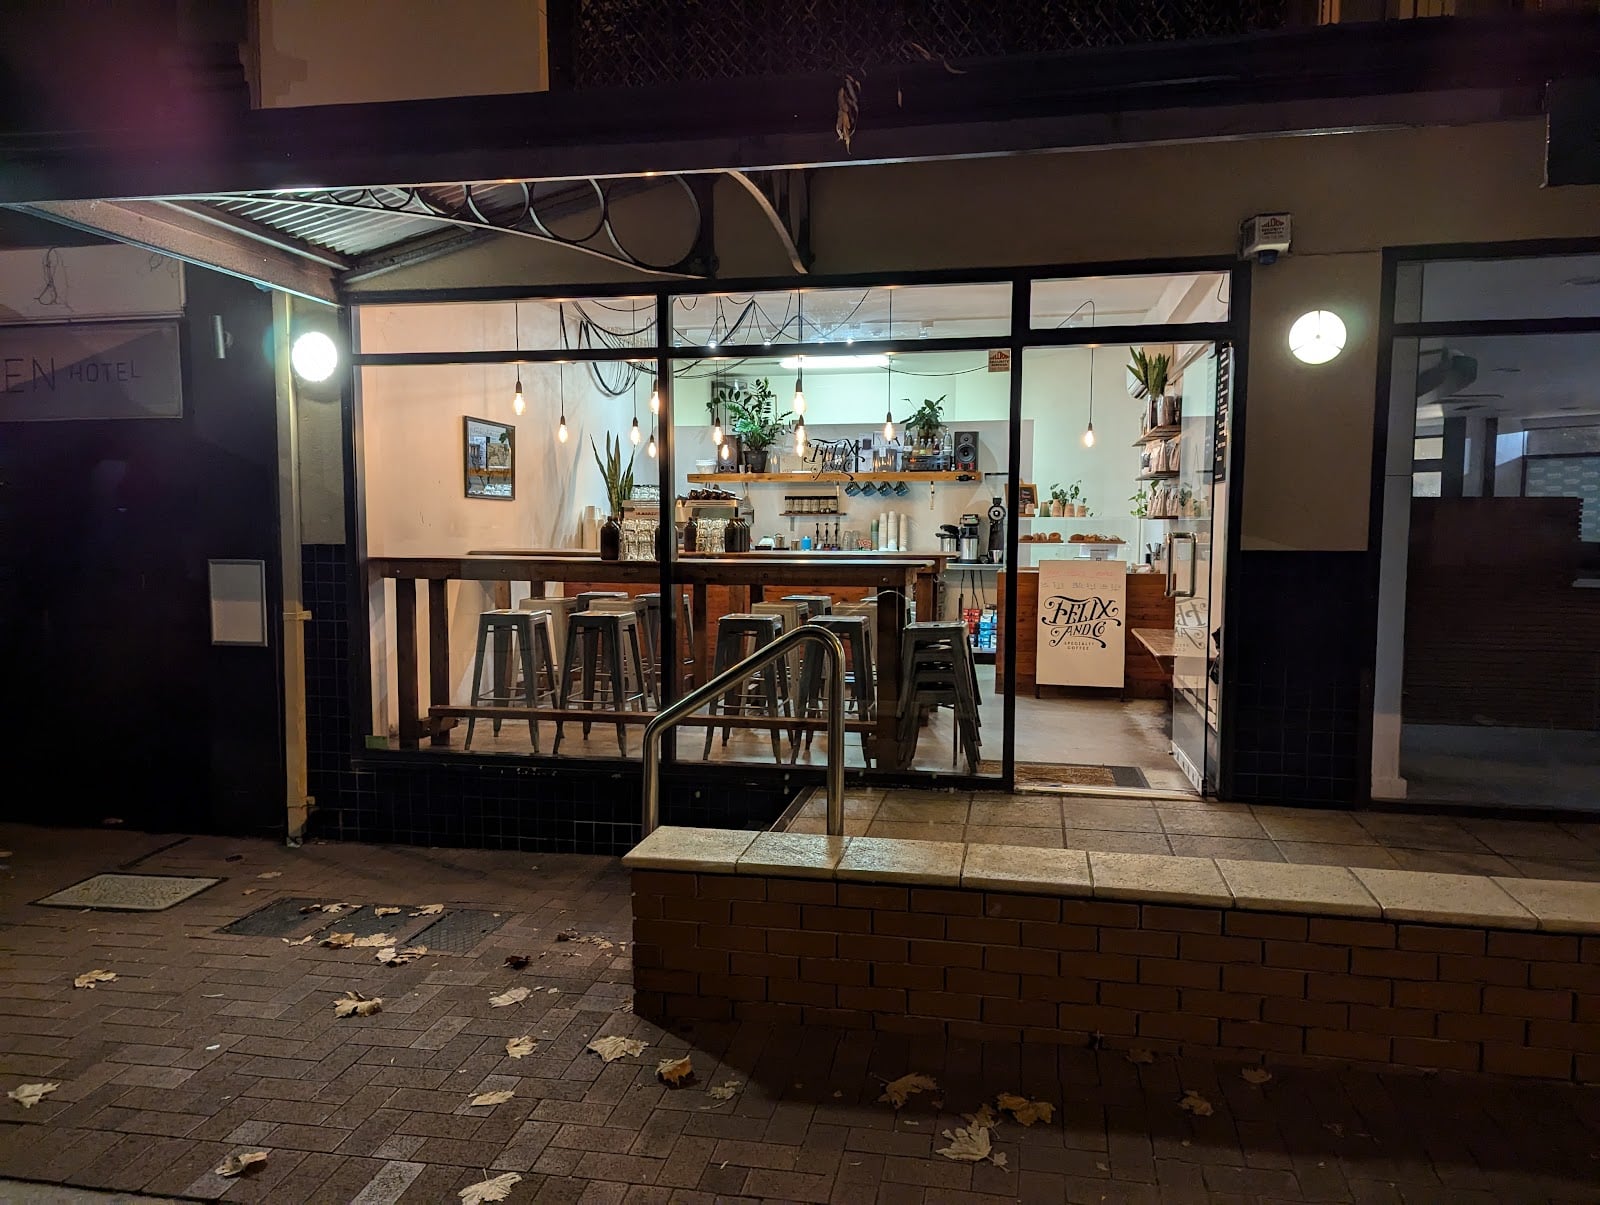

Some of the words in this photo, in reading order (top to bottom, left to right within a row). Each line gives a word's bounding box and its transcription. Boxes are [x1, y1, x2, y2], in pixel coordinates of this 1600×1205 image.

[0, 358, 56, 393] EN
[70, 360, 141, 382] HOTEL
[1043, 595, 1119, 625] FELIX
